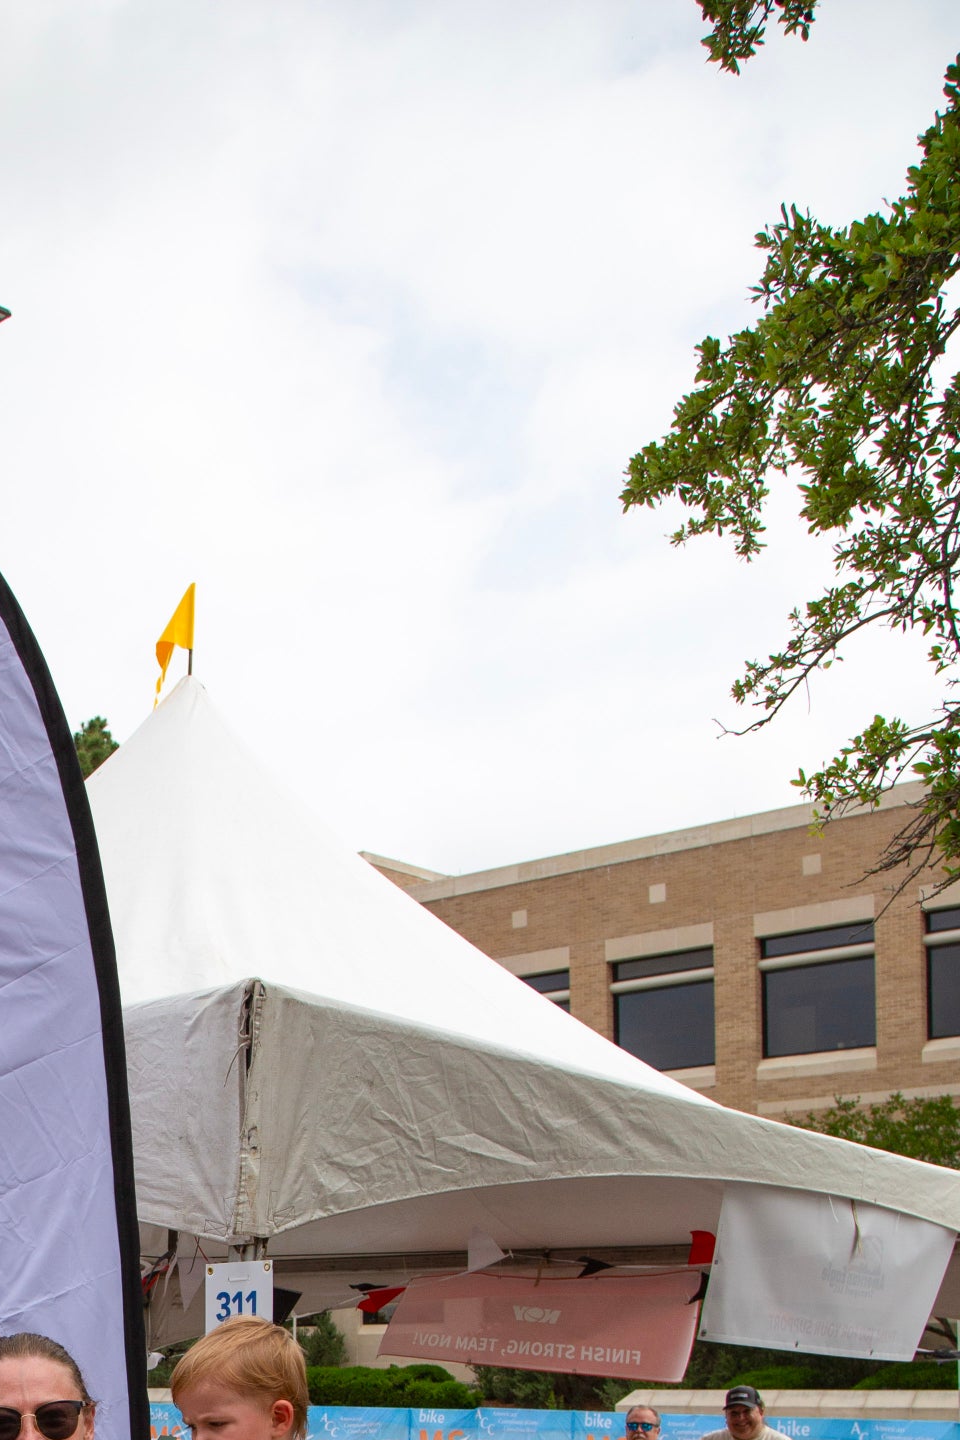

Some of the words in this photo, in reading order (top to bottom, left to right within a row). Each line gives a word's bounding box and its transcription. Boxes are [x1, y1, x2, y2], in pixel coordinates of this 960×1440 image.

[216, 1291, 257, 1322] 311
[419, 1409, 445, 1424] bike
[584, 1413, 612, 1429] bike
[777, 1420, 810, 1436] bike
